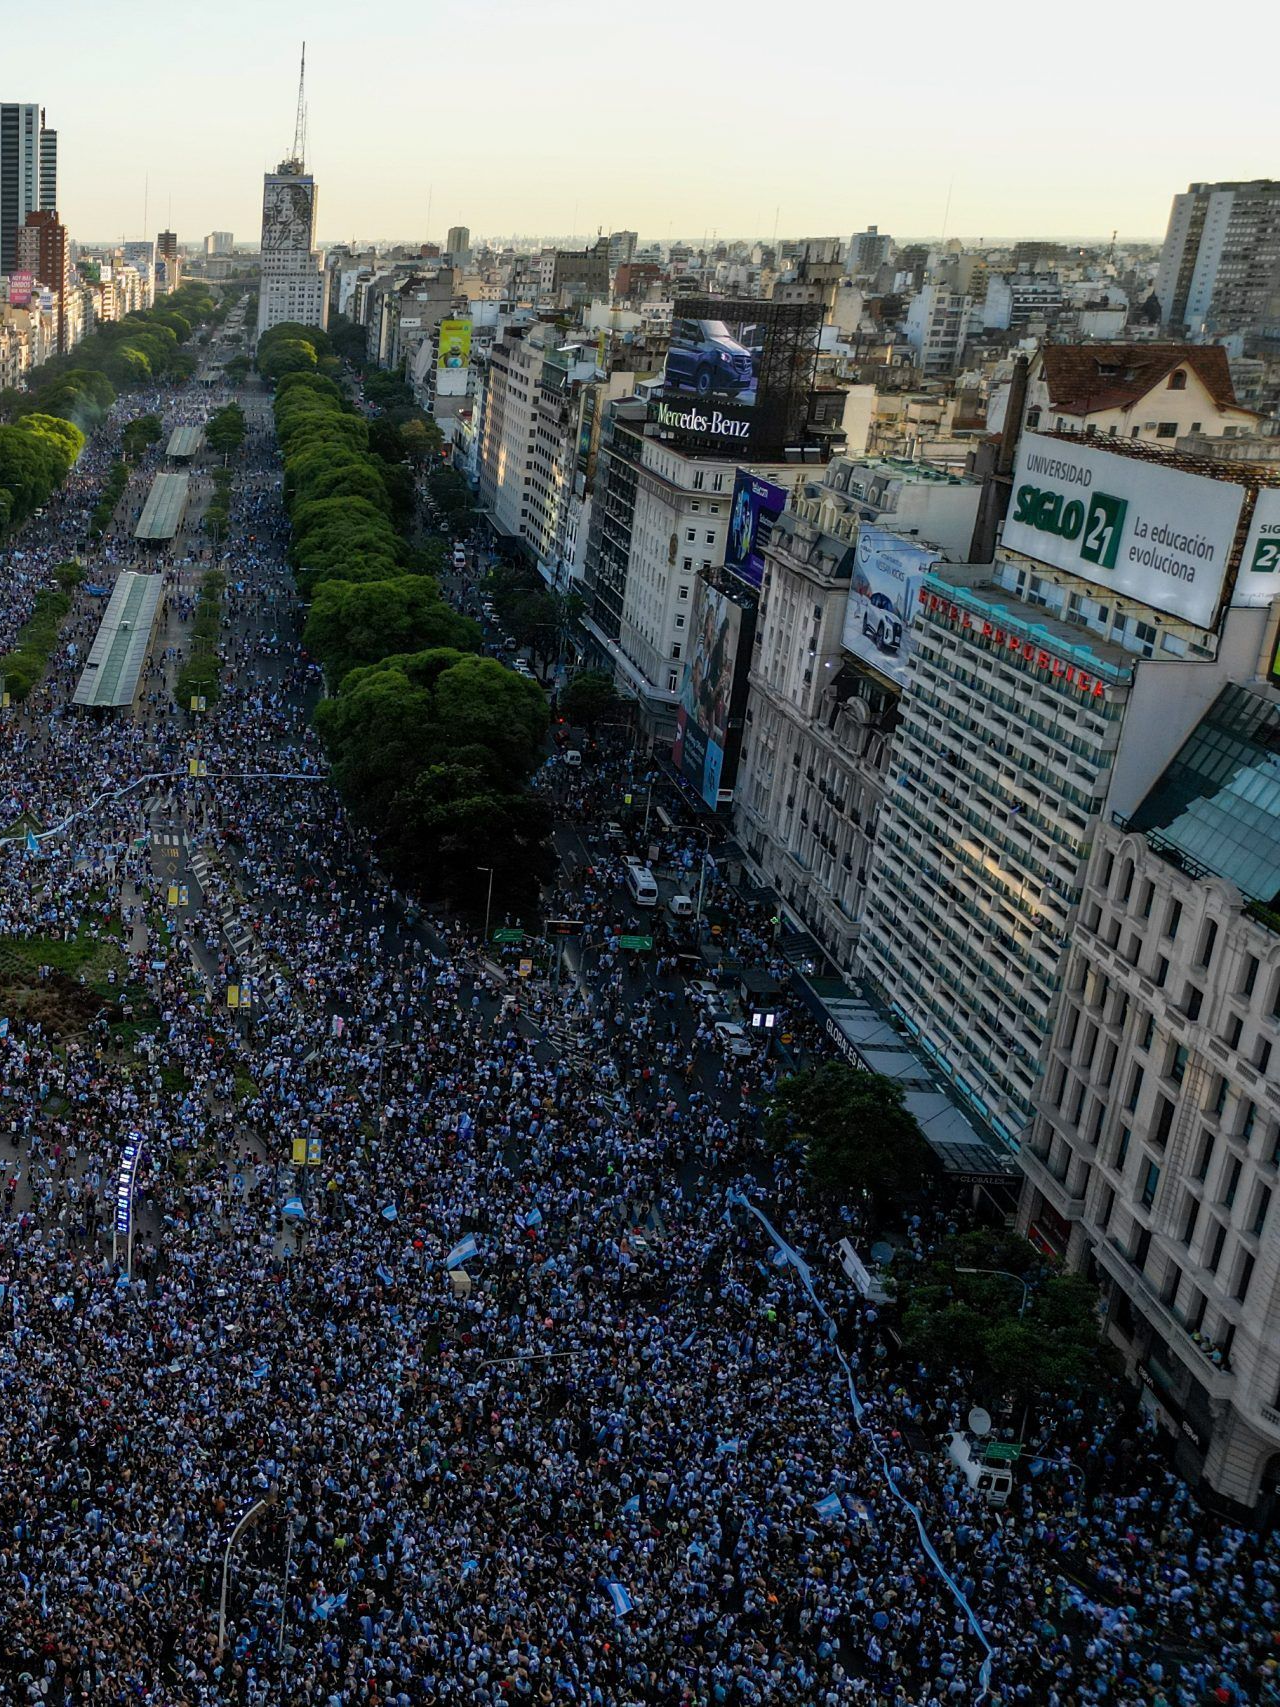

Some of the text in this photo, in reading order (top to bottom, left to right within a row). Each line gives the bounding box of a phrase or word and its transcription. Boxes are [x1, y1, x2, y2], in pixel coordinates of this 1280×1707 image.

[658, 402, 751, 438] Mercedes-Benz
[1026, 453, 1092, 487] UNIVERSIDAD
[1013, 484, 1115, 565] SIGLO 21
[1134, 516, 1214, 562] La educación
[1129, 545, 1196, 583] evoluciona
[918, 587, 1104, 698] HOTEL REPUBLICA
[1138, 1365, 1154, 1388] BBVA
[1182, 1421, 1199, 1446] BBVA
